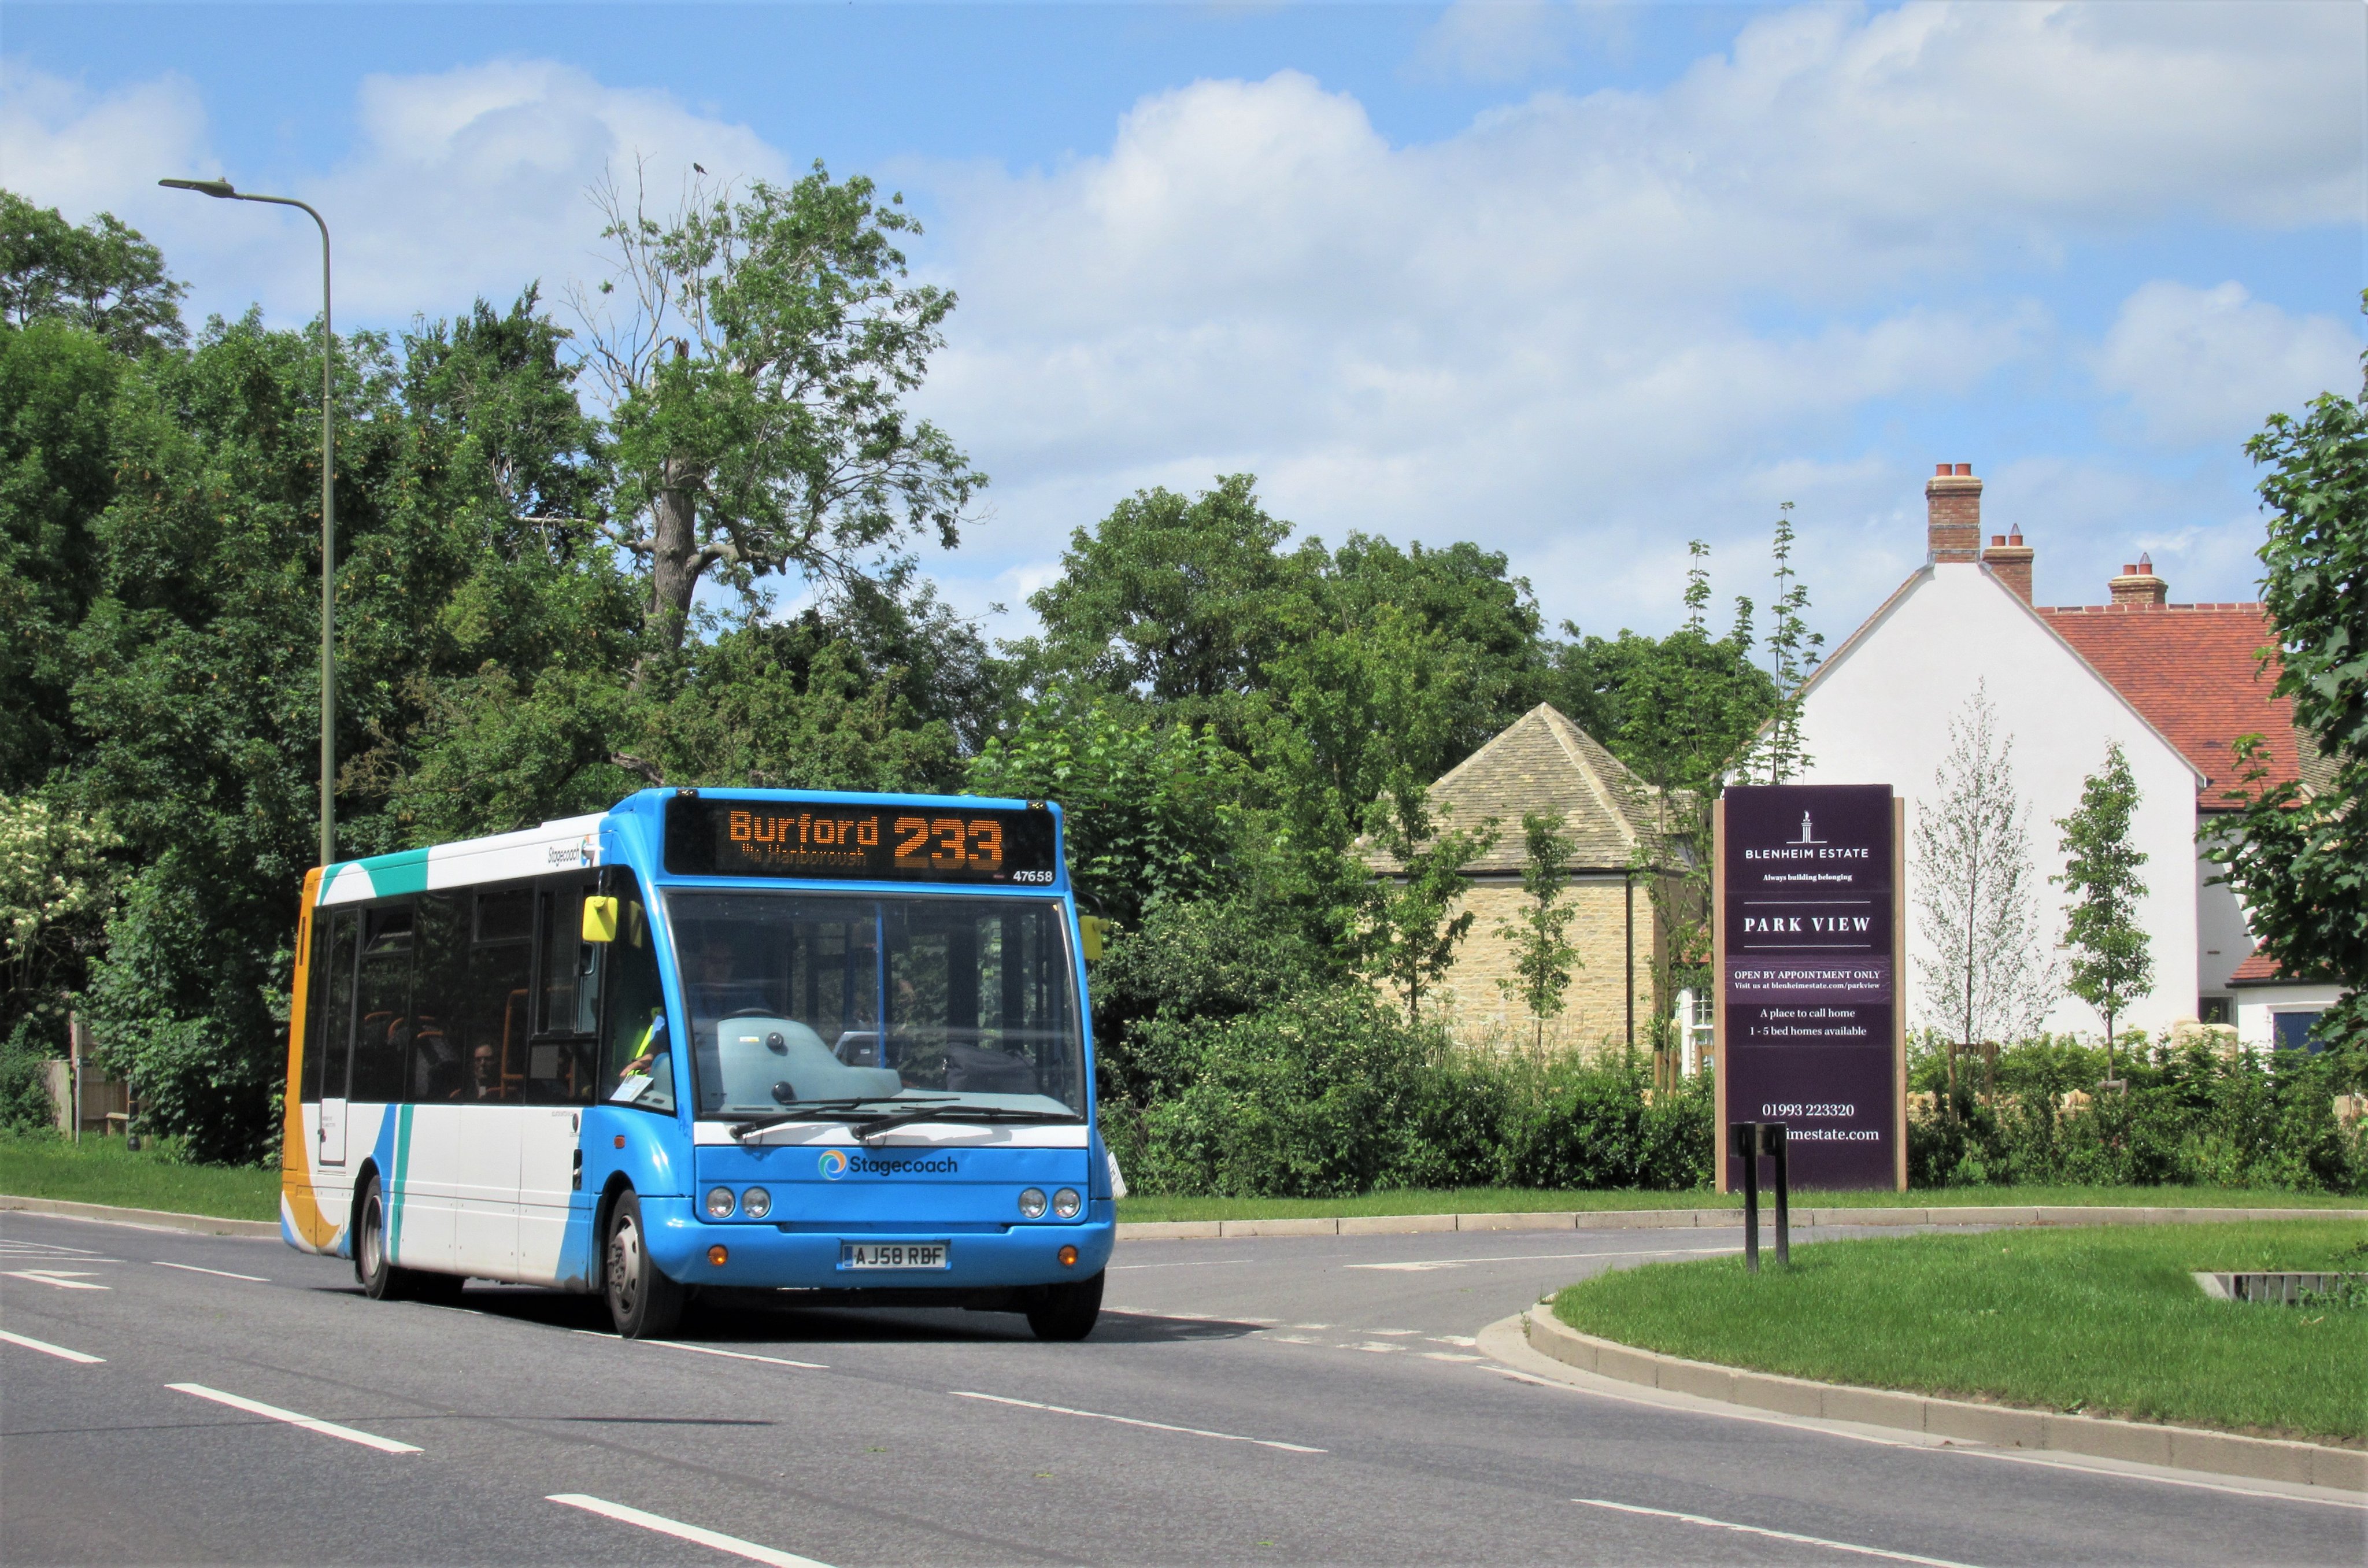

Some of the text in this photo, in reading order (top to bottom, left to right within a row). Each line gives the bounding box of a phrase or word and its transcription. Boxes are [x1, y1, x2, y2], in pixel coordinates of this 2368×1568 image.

[730, 811, 1003, 870] Burford 233
[1745, 848, 1869, 859] BLENHEIM ESTATE
[1013, 871, 1053, 882] 47658
[1763, 874, 1786, 882] Always
[1788, 874, 1817, 882] building
[1744, 917, 1870, 932] PARK VIEW
[1734, 971, 1879, 979] OPEN BY APPOINTMENT ONLY
[1771, 982, 1880, 990] blenheimestate.com/parkview
[1760, 1008, 1855, 1020] A place to call home
[1750, 1027, 1755, 1036] 1
[1763, 1027, 1769, 1036] 5
[1771, 1026, 1789, 1036] bed
[1790, 1026, 1822, 1036] homes
[1824, 1026, 1867, 1036] available
[1762, 1104, 1855, 1116] 01993 223320
[1786, 1128, 1879, 1140] imestate.com
[850, 1156, 958, 1176] Stagecoach
[856, 1247, 944, 1264] AJ58 RBF
